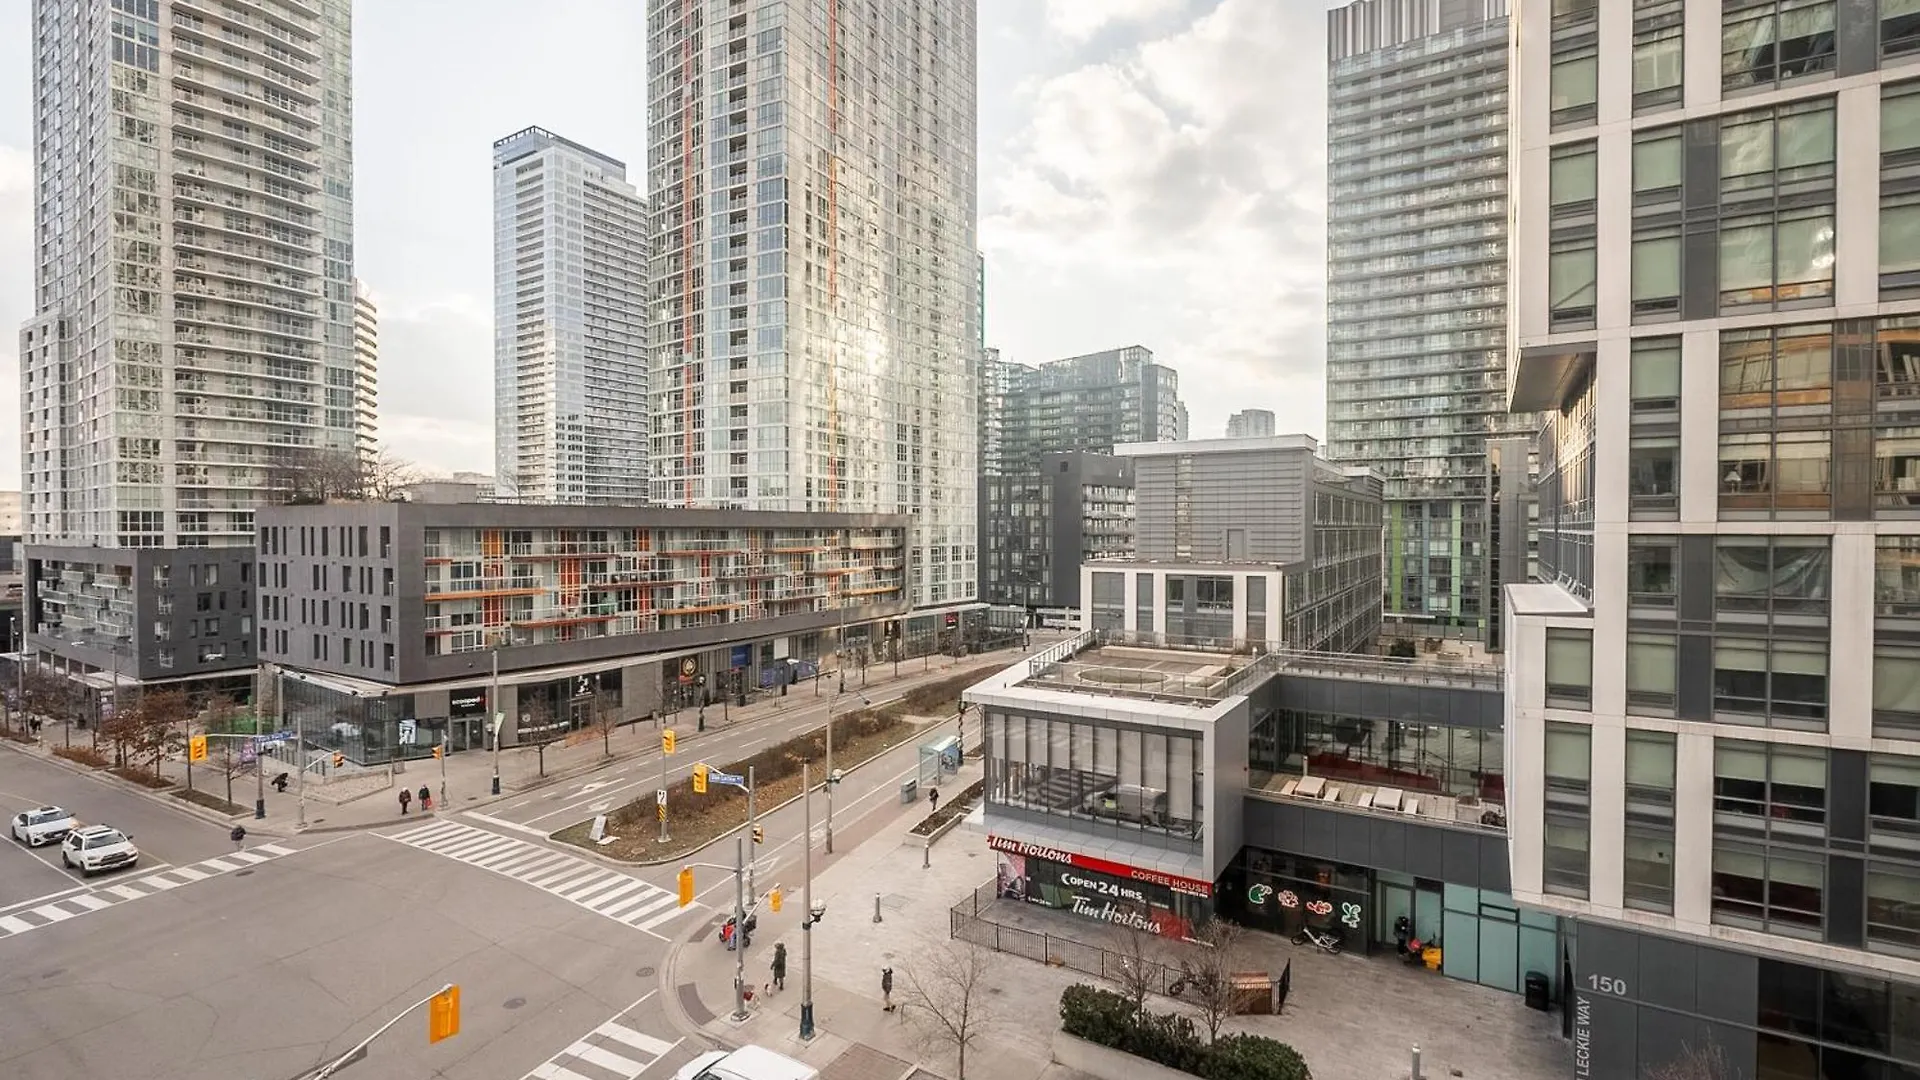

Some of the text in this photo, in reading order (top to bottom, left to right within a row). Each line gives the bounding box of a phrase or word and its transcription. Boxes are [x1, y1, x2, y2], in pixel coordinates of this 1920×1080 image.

[987, 836, 1072, 864] Tim Hortons
[1098, 881, 1119, 897] 24
[1131, 870, 1170, 886] COFFEE
[1173, 879, 1208, 893] HOUSE
[1072, 895, 1161, 934] Tim Hortons
[1588, 974, 1627, 996] 150
[1577, 996, 1590, 1025] WAY
[1577, 1028, 1590, 1076] LECKIE
